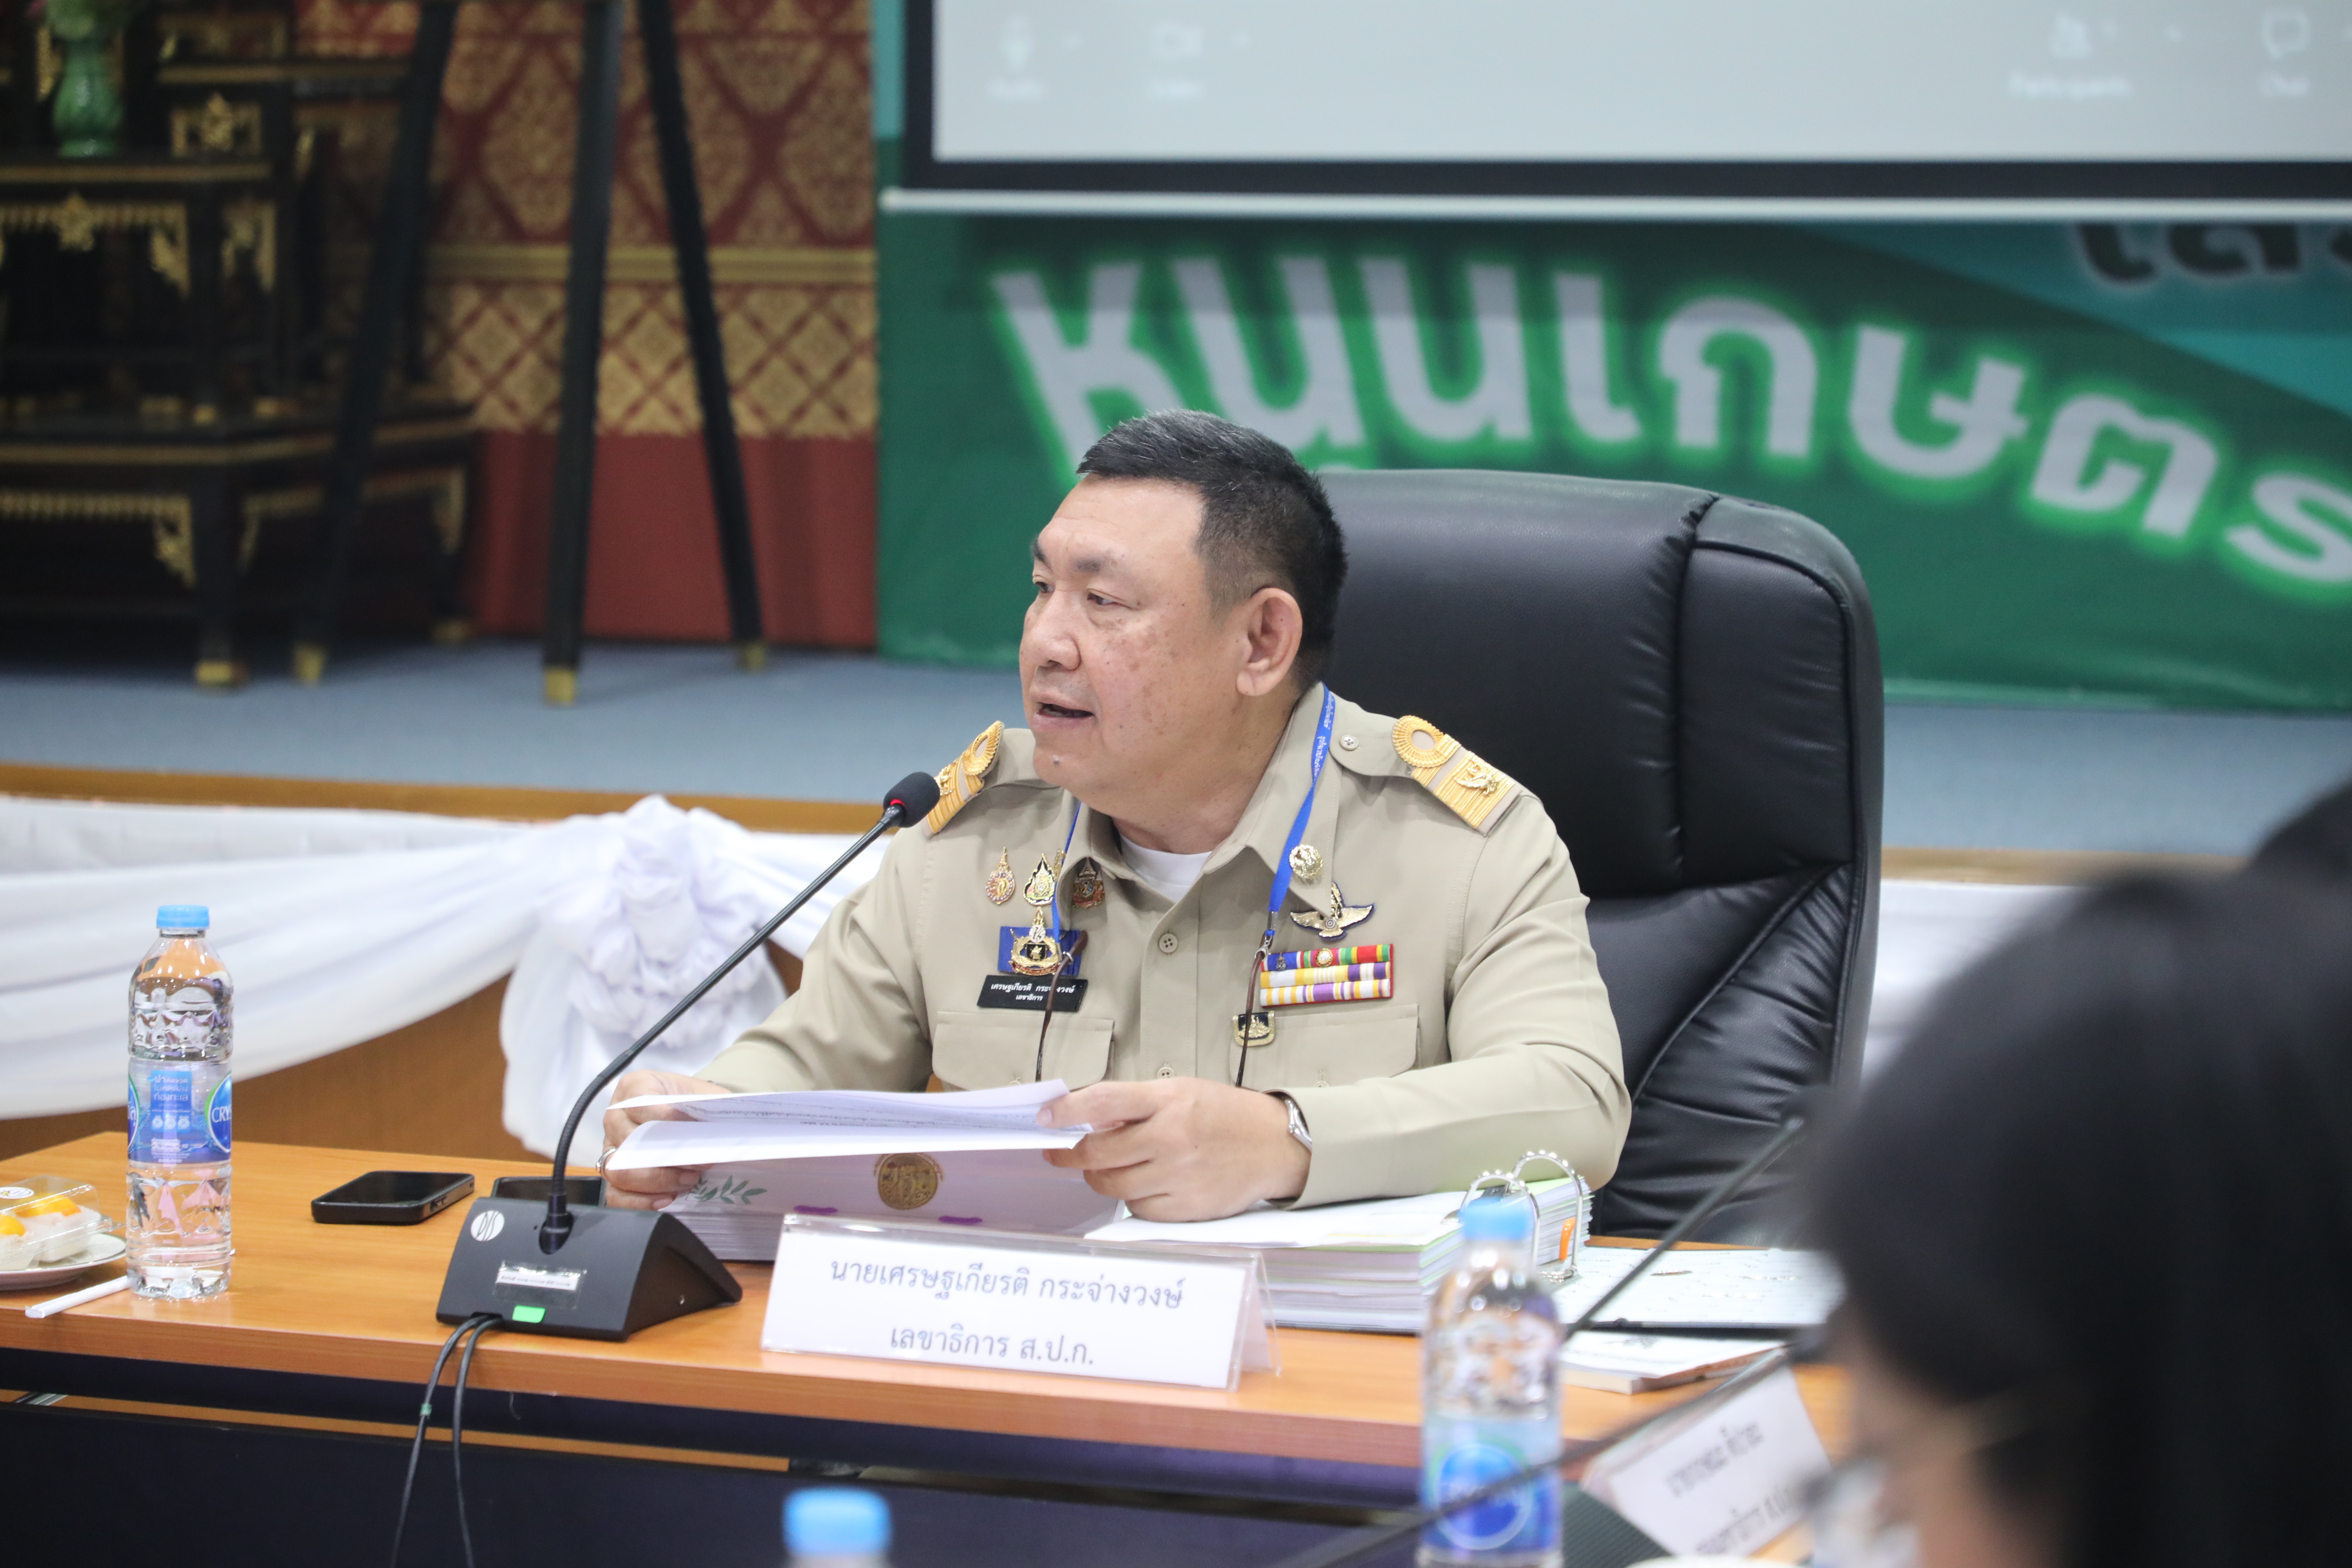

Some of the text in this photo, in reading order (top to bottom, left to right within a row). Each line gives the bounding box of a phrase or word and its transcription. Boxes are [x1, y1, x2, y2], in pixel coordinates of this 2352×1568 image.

[991, 256, 2352, 583] หนนเกษตร
[831, 1261, 1187, 1309] นายเศรษฐเกียรติ กระจ่างวงษ์
[890, 1322, 1094, 1365] เลขาธิการ ส.ป.ก.
